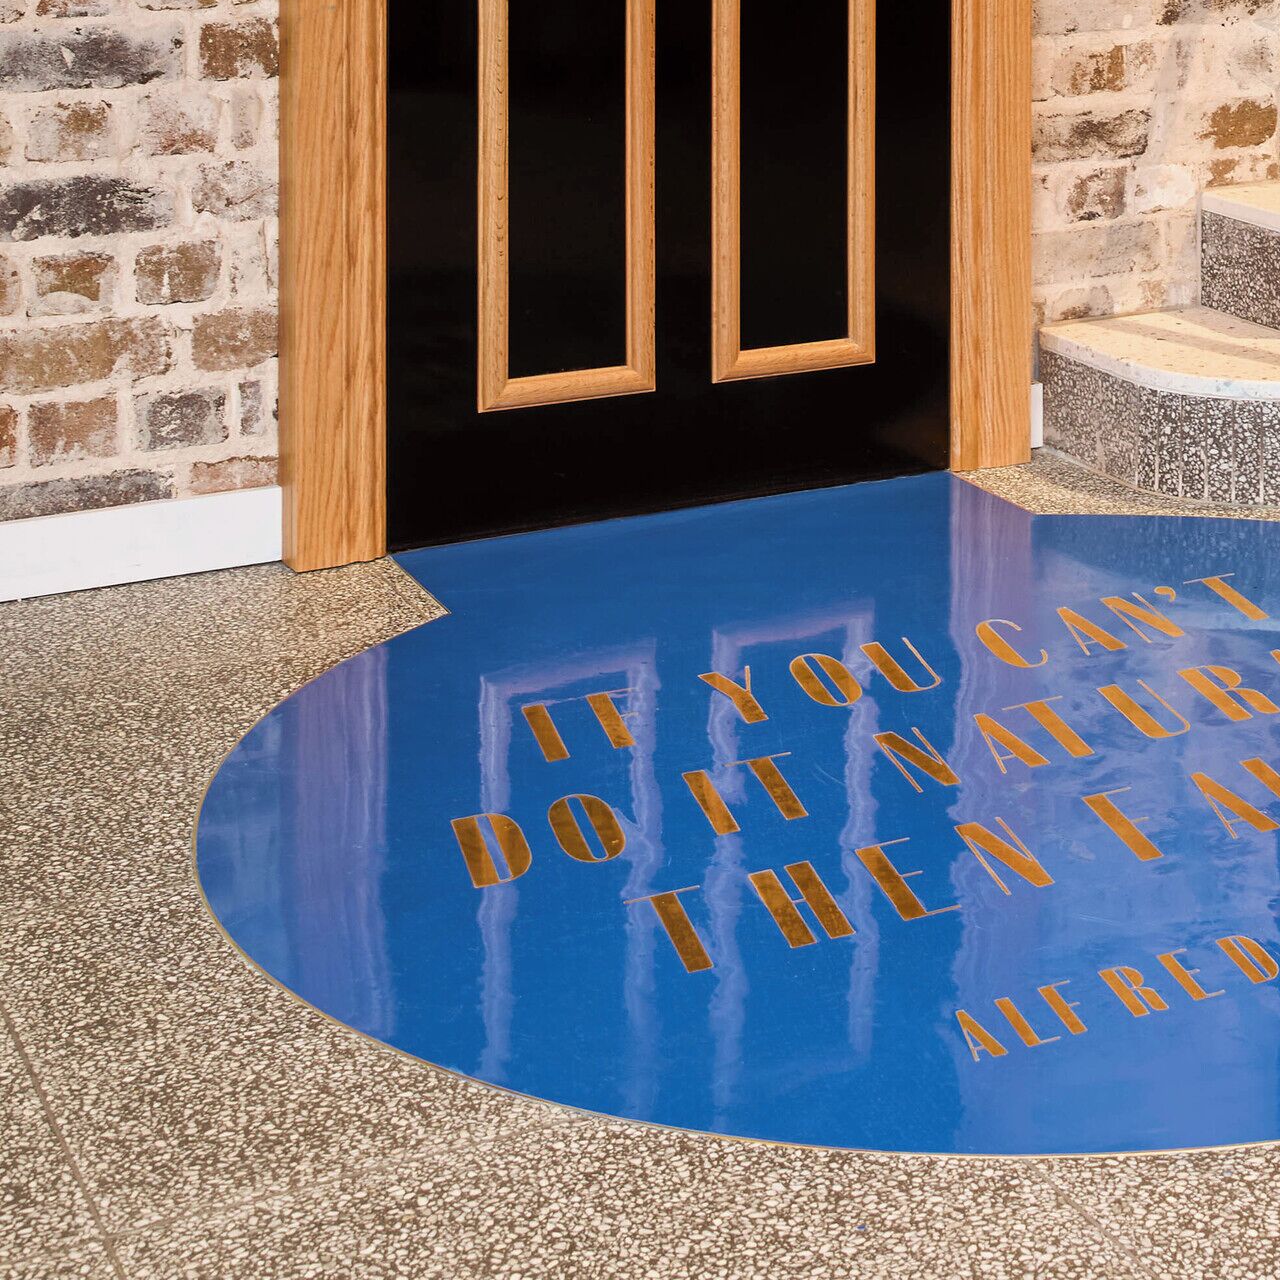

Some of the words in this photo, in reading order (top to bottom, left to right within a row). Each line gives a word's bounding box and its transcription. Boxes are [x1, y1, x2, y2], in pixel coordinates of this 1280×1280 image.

[521, 687, 638, 763] IF
[698, 636, 942, 724] YOU
[975, 572, 1271, 670] CAN'T
[450, 793, 627, 889] DO
[681, 751, 809, 836] IT
[623, 816, 1056, 973] THEN
[954, 933, 1280, 1063] ALFRED
